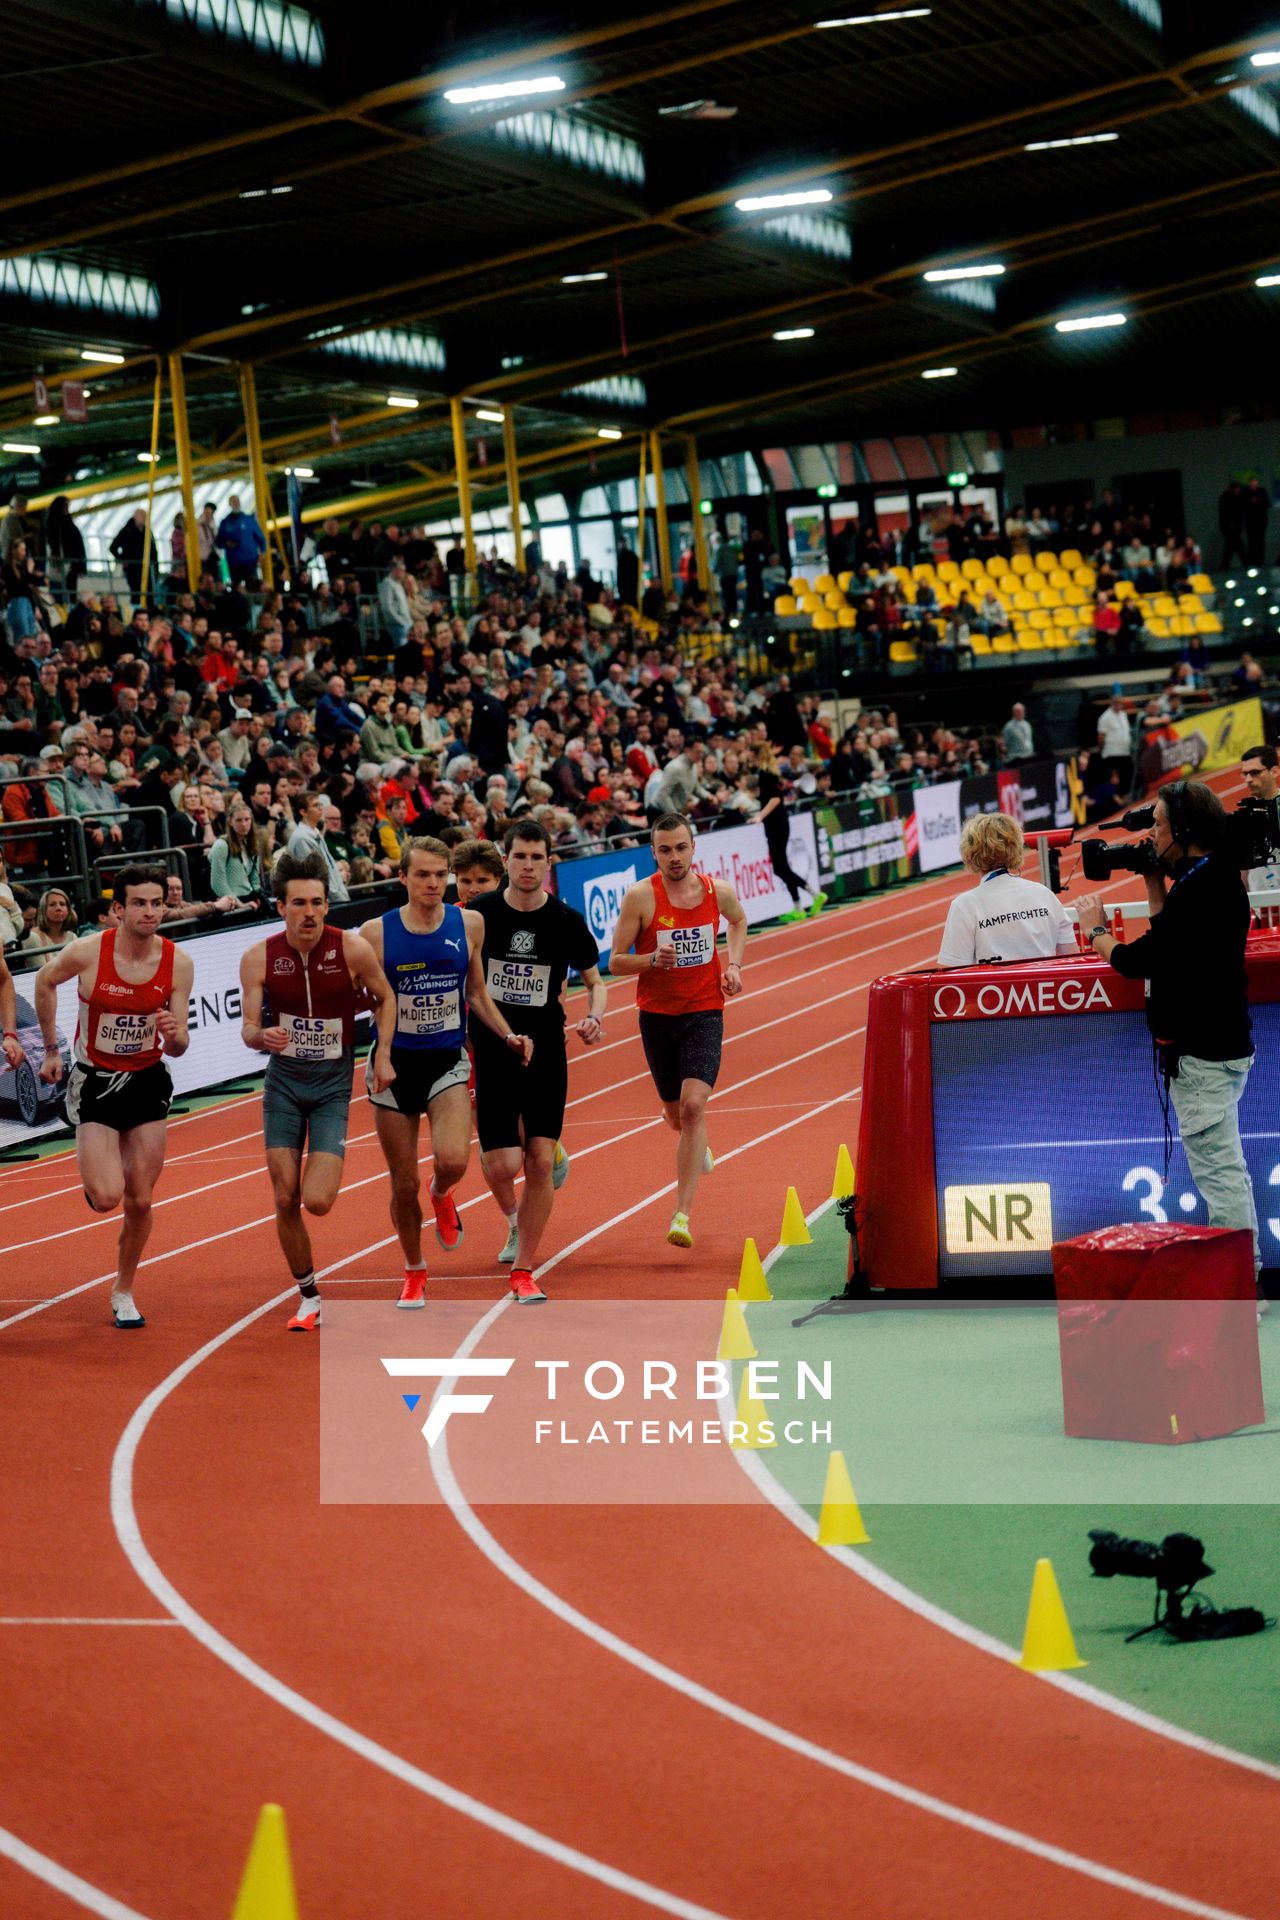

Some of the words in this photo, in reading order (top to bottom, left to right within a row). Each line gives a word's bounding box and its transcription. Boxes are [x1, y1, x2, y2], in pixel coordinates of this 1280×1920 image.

[978, 907, 1049, 929] KAMPFRICHTER
[675, 939, 710, 954] ENZEL
[413, 974, 430, 982] LAV
[414, 979, 459, 990] TÜBINGEN
[492, 972, 543, 992] GERLING
[109, 984, 135, 995] Brillux
[977, 978, 1112, 1015] OMEGA
[100, 1024, 155, 1042] SIETMANN
[964, 1194, 1034, 1242] NR
